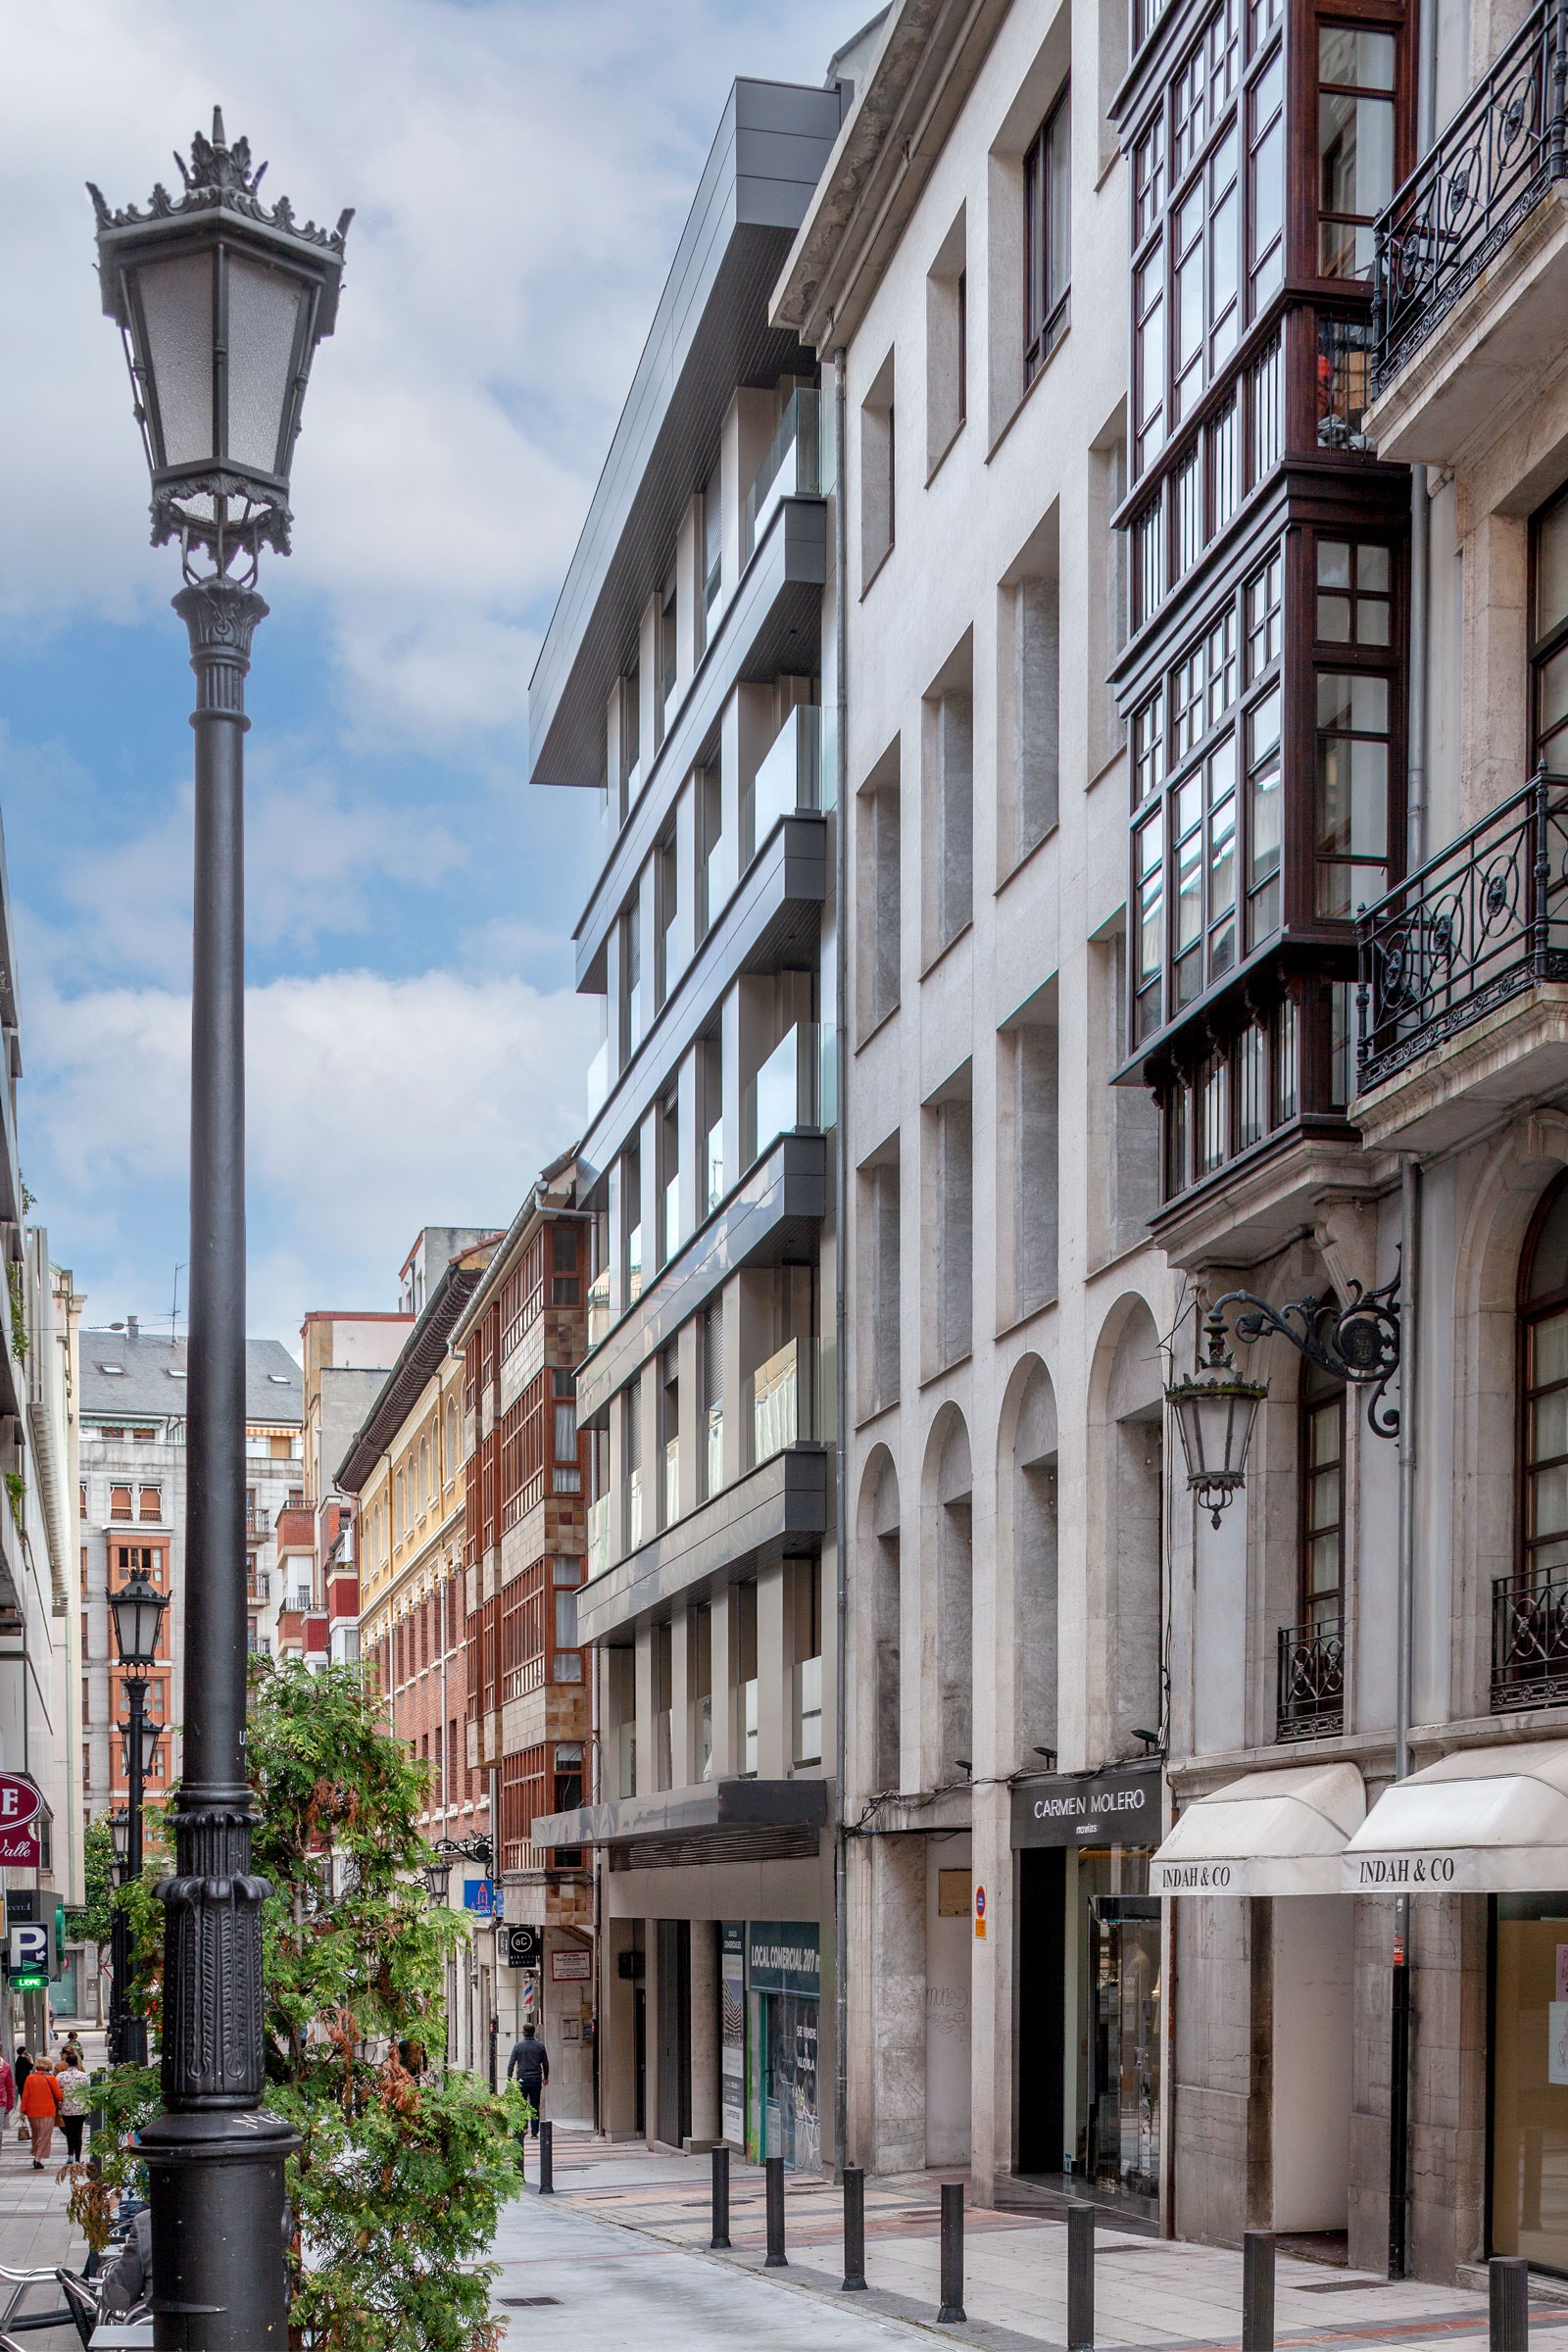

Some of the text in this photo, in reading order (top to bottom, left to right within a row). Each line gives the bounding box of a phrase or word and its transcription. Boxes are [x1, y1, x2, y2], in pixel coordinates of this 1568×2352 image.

[1034, 1788, 1145, 1819] CARMEN MOLERO
[1075, 1823, 1099, 1835] novias
[1162, 1866, 1230, 1887] INDAH & CO
[1358, 1857, 1454, 1883] INDAH & CO
[11, 1927, 46, 1967] P
[514, 1936, 528, 1946] aC
[751, 1945, 769, 1967] LOCAL
[770, 1946, 802, 1971] COMERCIAL
[804, 1948, 815, 1972] 207
[797, 2026, 816, 2039] SE VENDE
[797, 2058, 815, 2072] ALQUILA
